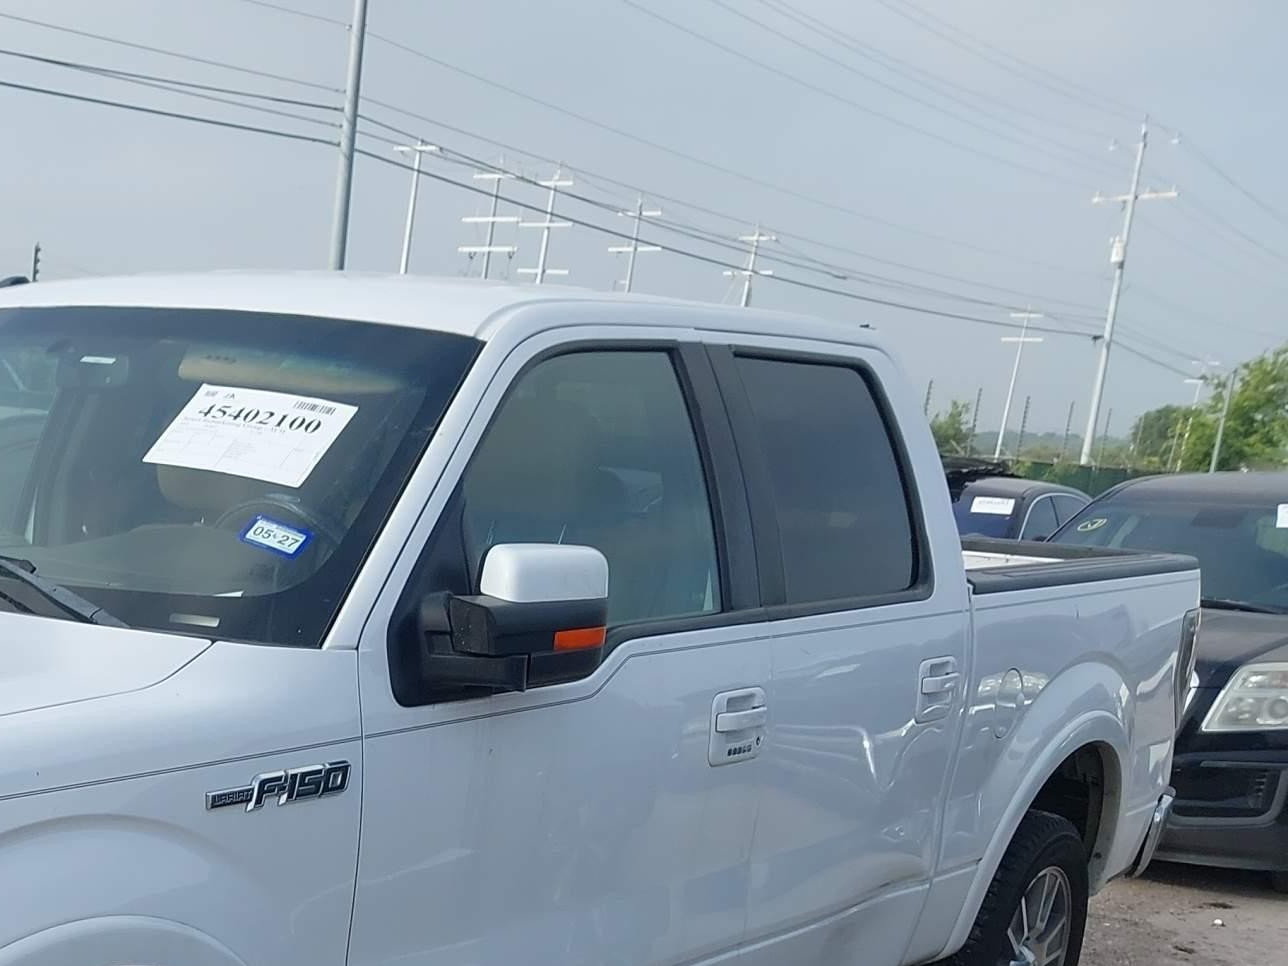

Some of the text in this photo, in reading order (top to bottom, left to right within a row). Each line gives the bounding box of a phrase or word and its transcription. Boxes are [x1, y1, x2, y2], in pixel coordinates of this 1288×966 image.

[198, 403, 322, 434] 45402100
[253, 526, 300, 547] 05 27
